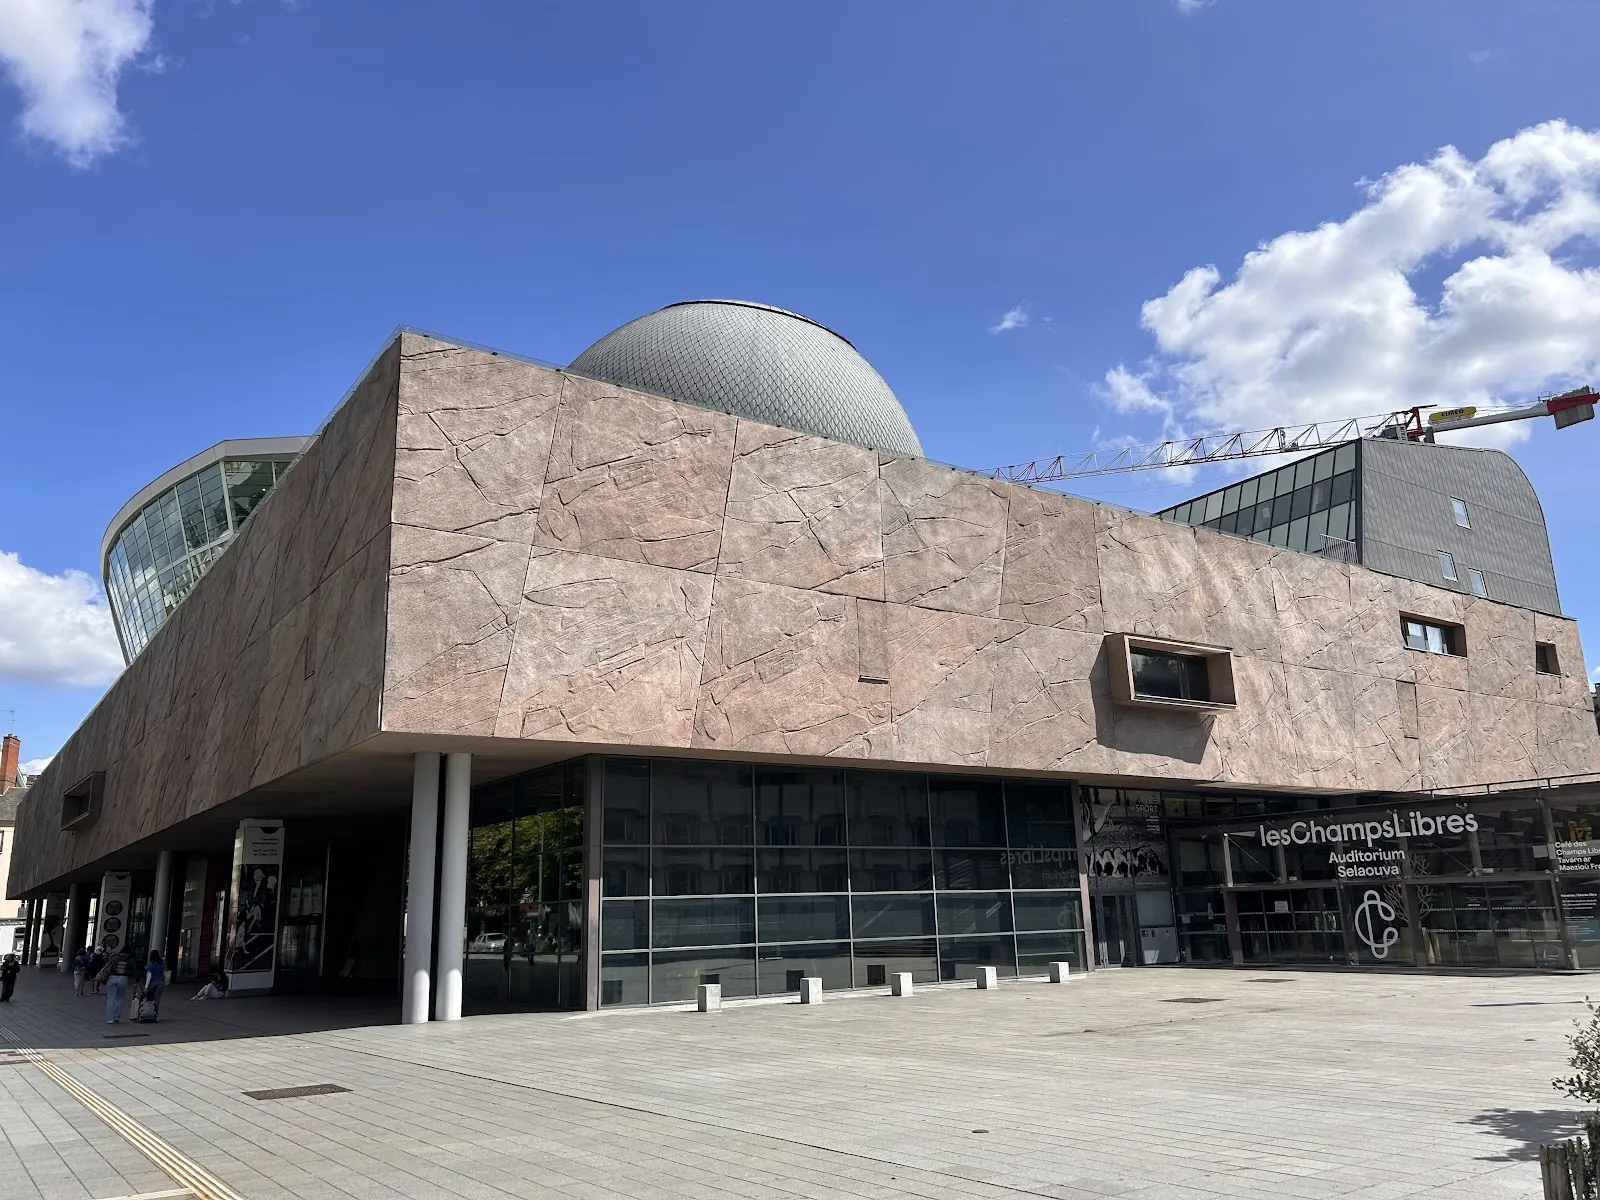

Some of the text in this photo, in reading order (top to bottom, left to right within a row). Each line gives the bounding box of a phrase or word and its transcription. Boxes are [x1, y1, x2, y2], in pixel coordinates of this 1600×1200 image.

[1136, 804, 1158, 813] SPORT
[1259, 811, 1479, 847] lesChampsLibres
[1328, 849, 1406, 864] Auditorium
[1556, 848, 1587, 857] Champs
[1337, 864, 1400, 878] Selaouva
[1559, 863, 1589, 871] Maezioù
